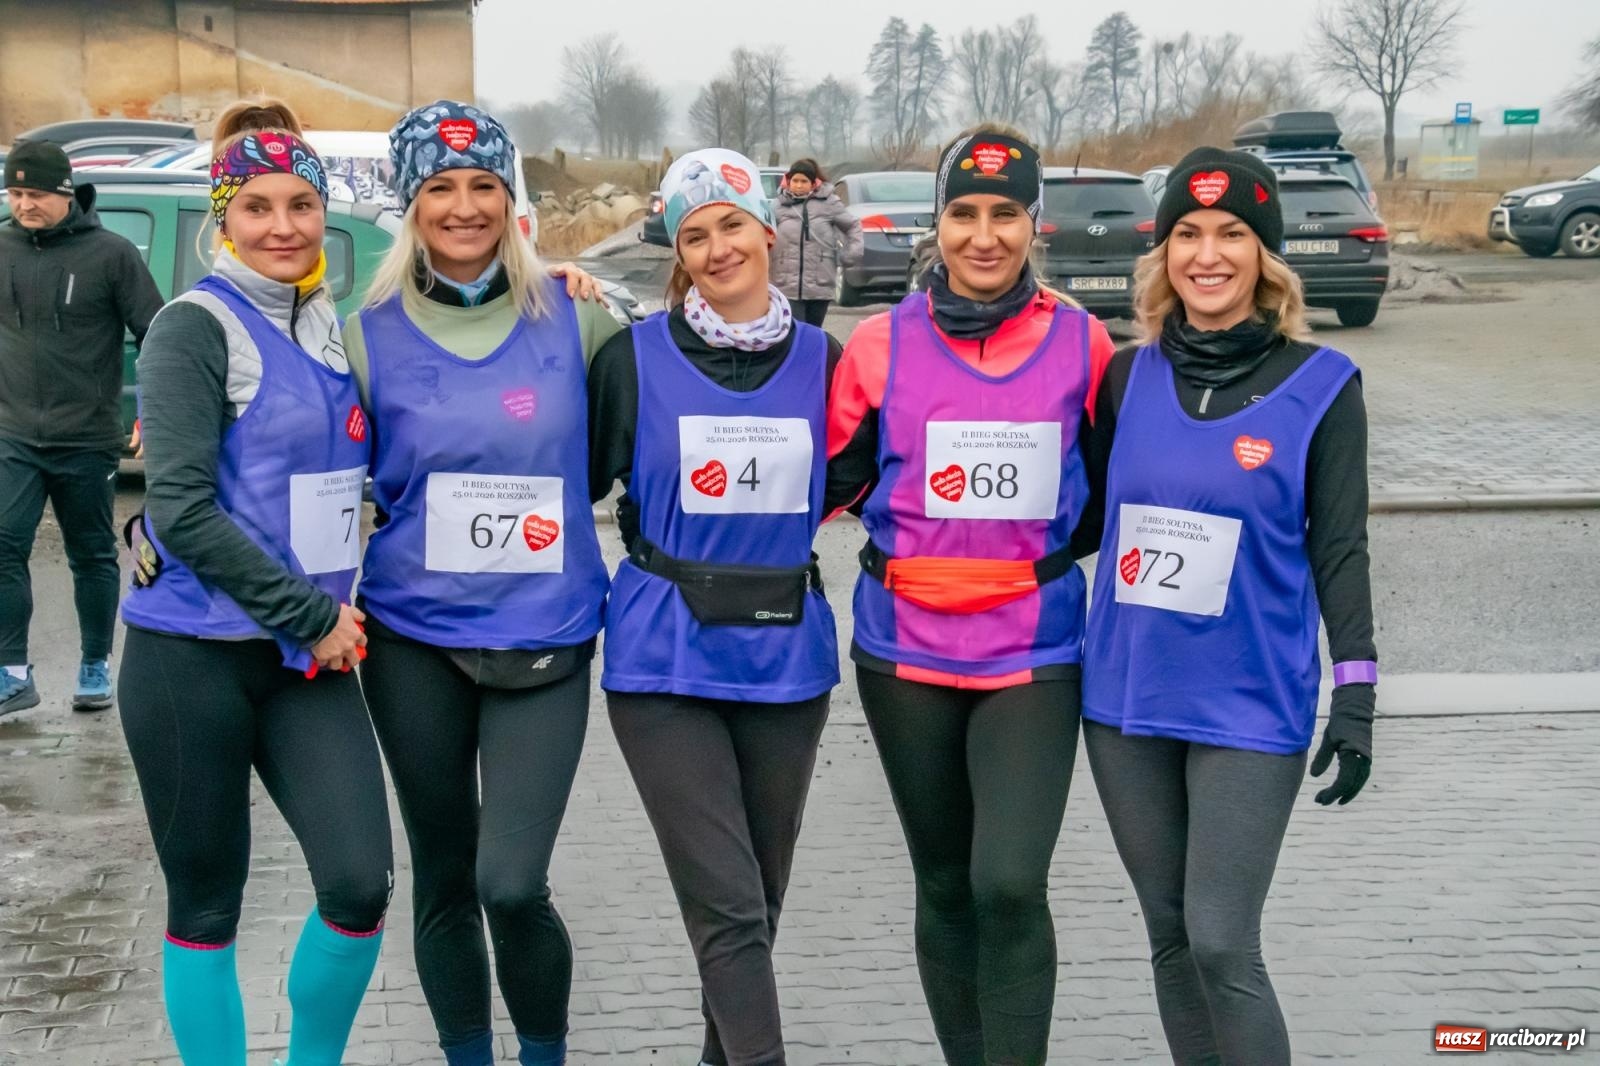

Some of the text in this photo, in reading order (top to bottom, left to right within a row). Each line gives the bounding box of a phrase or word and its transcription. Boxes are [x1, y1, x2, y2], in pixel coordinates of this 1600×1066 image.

[1288, 241, 1308, 252] SLU
[1074, 278, 1124, 289] SRC RX89
[714, 426, 780, 434] II BIEG SOŁTYSA
[961, 431, 1030, 440] II BIEG SOŁTYSA
[706, 434, 789, 444] 25.01.2026 ROSZKÓW
[952, 440, 1039, 450] 25.01.2026 ROSZKÓW
[737, 457, 761, 492] 4
[970, 462, 1019, 499] 68
[462, 480, 531, 492] II BIEG SOŁTYSA
[452, 490, 538, 500] 25.01.2026 ROSZKÓW
[342, 507, 355, 544] 7
[1148, 516, 1165, 526] BIEG
[1165, 518, 1204, 532] SOŁTYSA
[470, 513, 520, 549] 67
[1167, 528, 1212, 543] ROSZKÓW
[1140, 548, 1185, 590] 72
[532, 654, 554, 670] 4F
